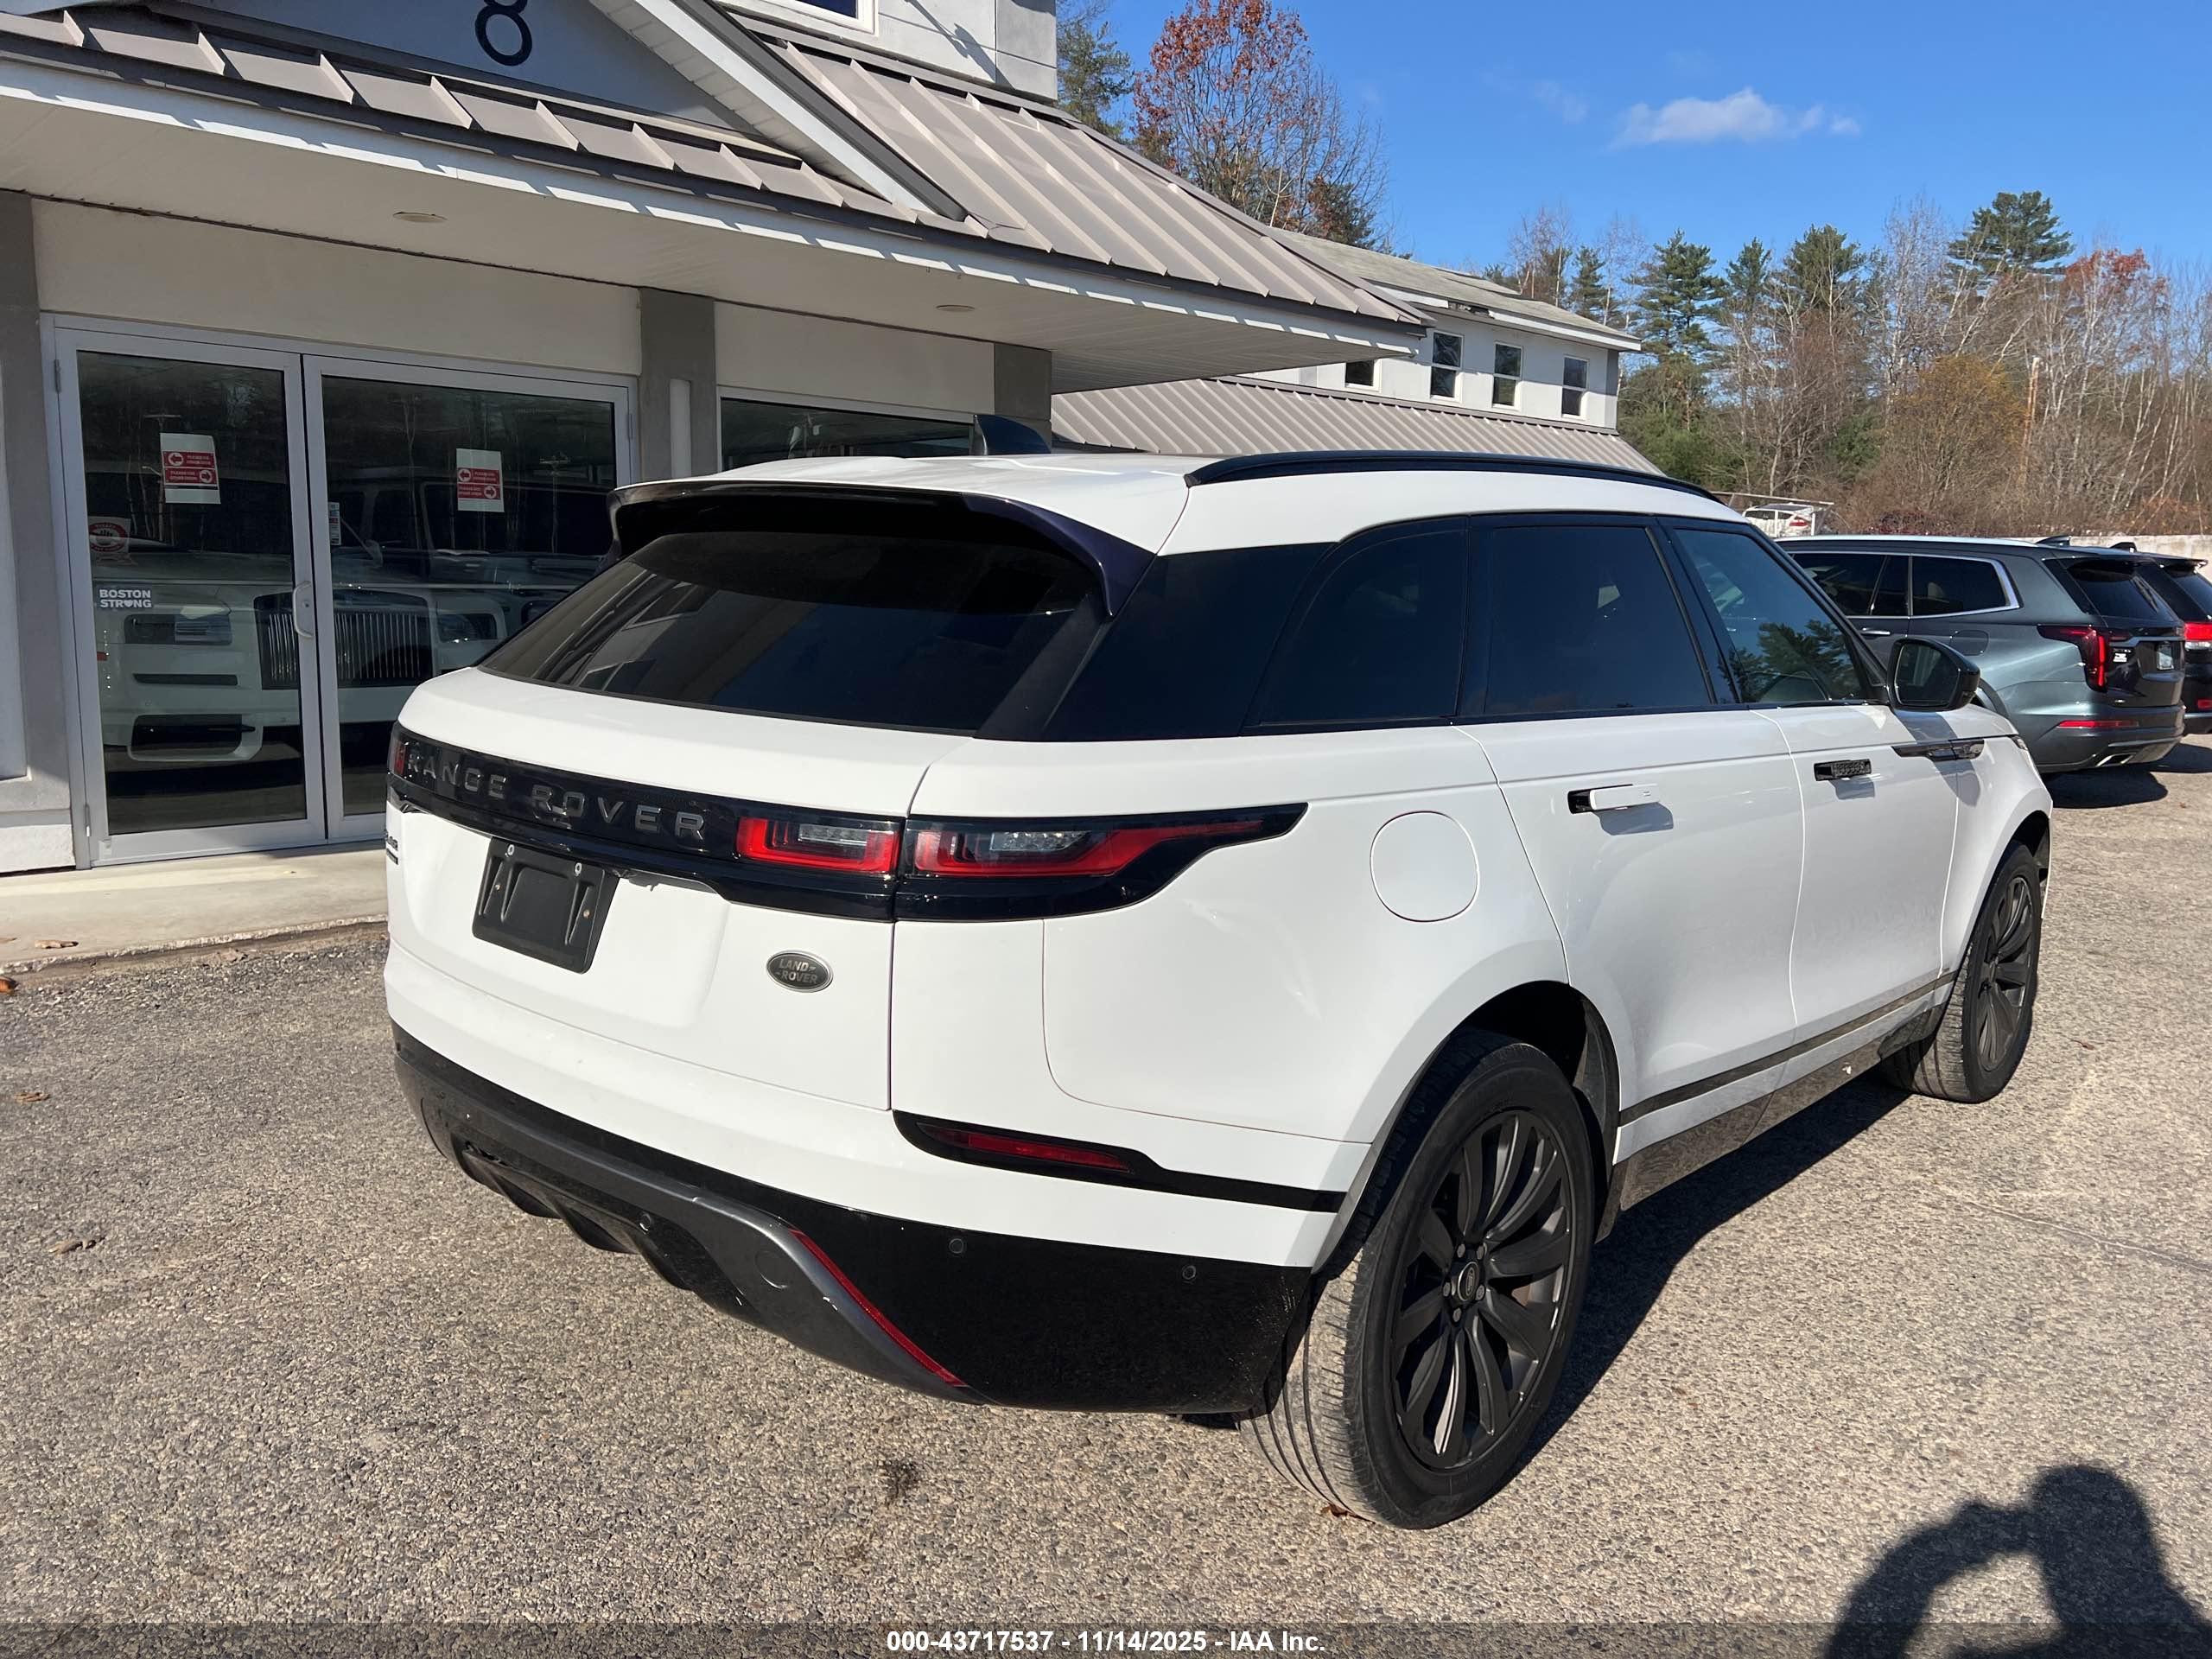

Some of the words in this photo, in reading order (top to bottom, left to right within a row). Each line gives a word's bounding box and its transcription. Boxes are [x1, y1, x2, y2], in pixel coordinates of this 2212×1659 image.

[474, 0, 532, 66] 8
[99, 589, 151, 599] BOSTON
[408, 753, 506, 799] RANGE
[531, 784, 705, 841] ROVER
[779, 958, 810, 972] LAND
[780, 969, 817, 983] ROVER
